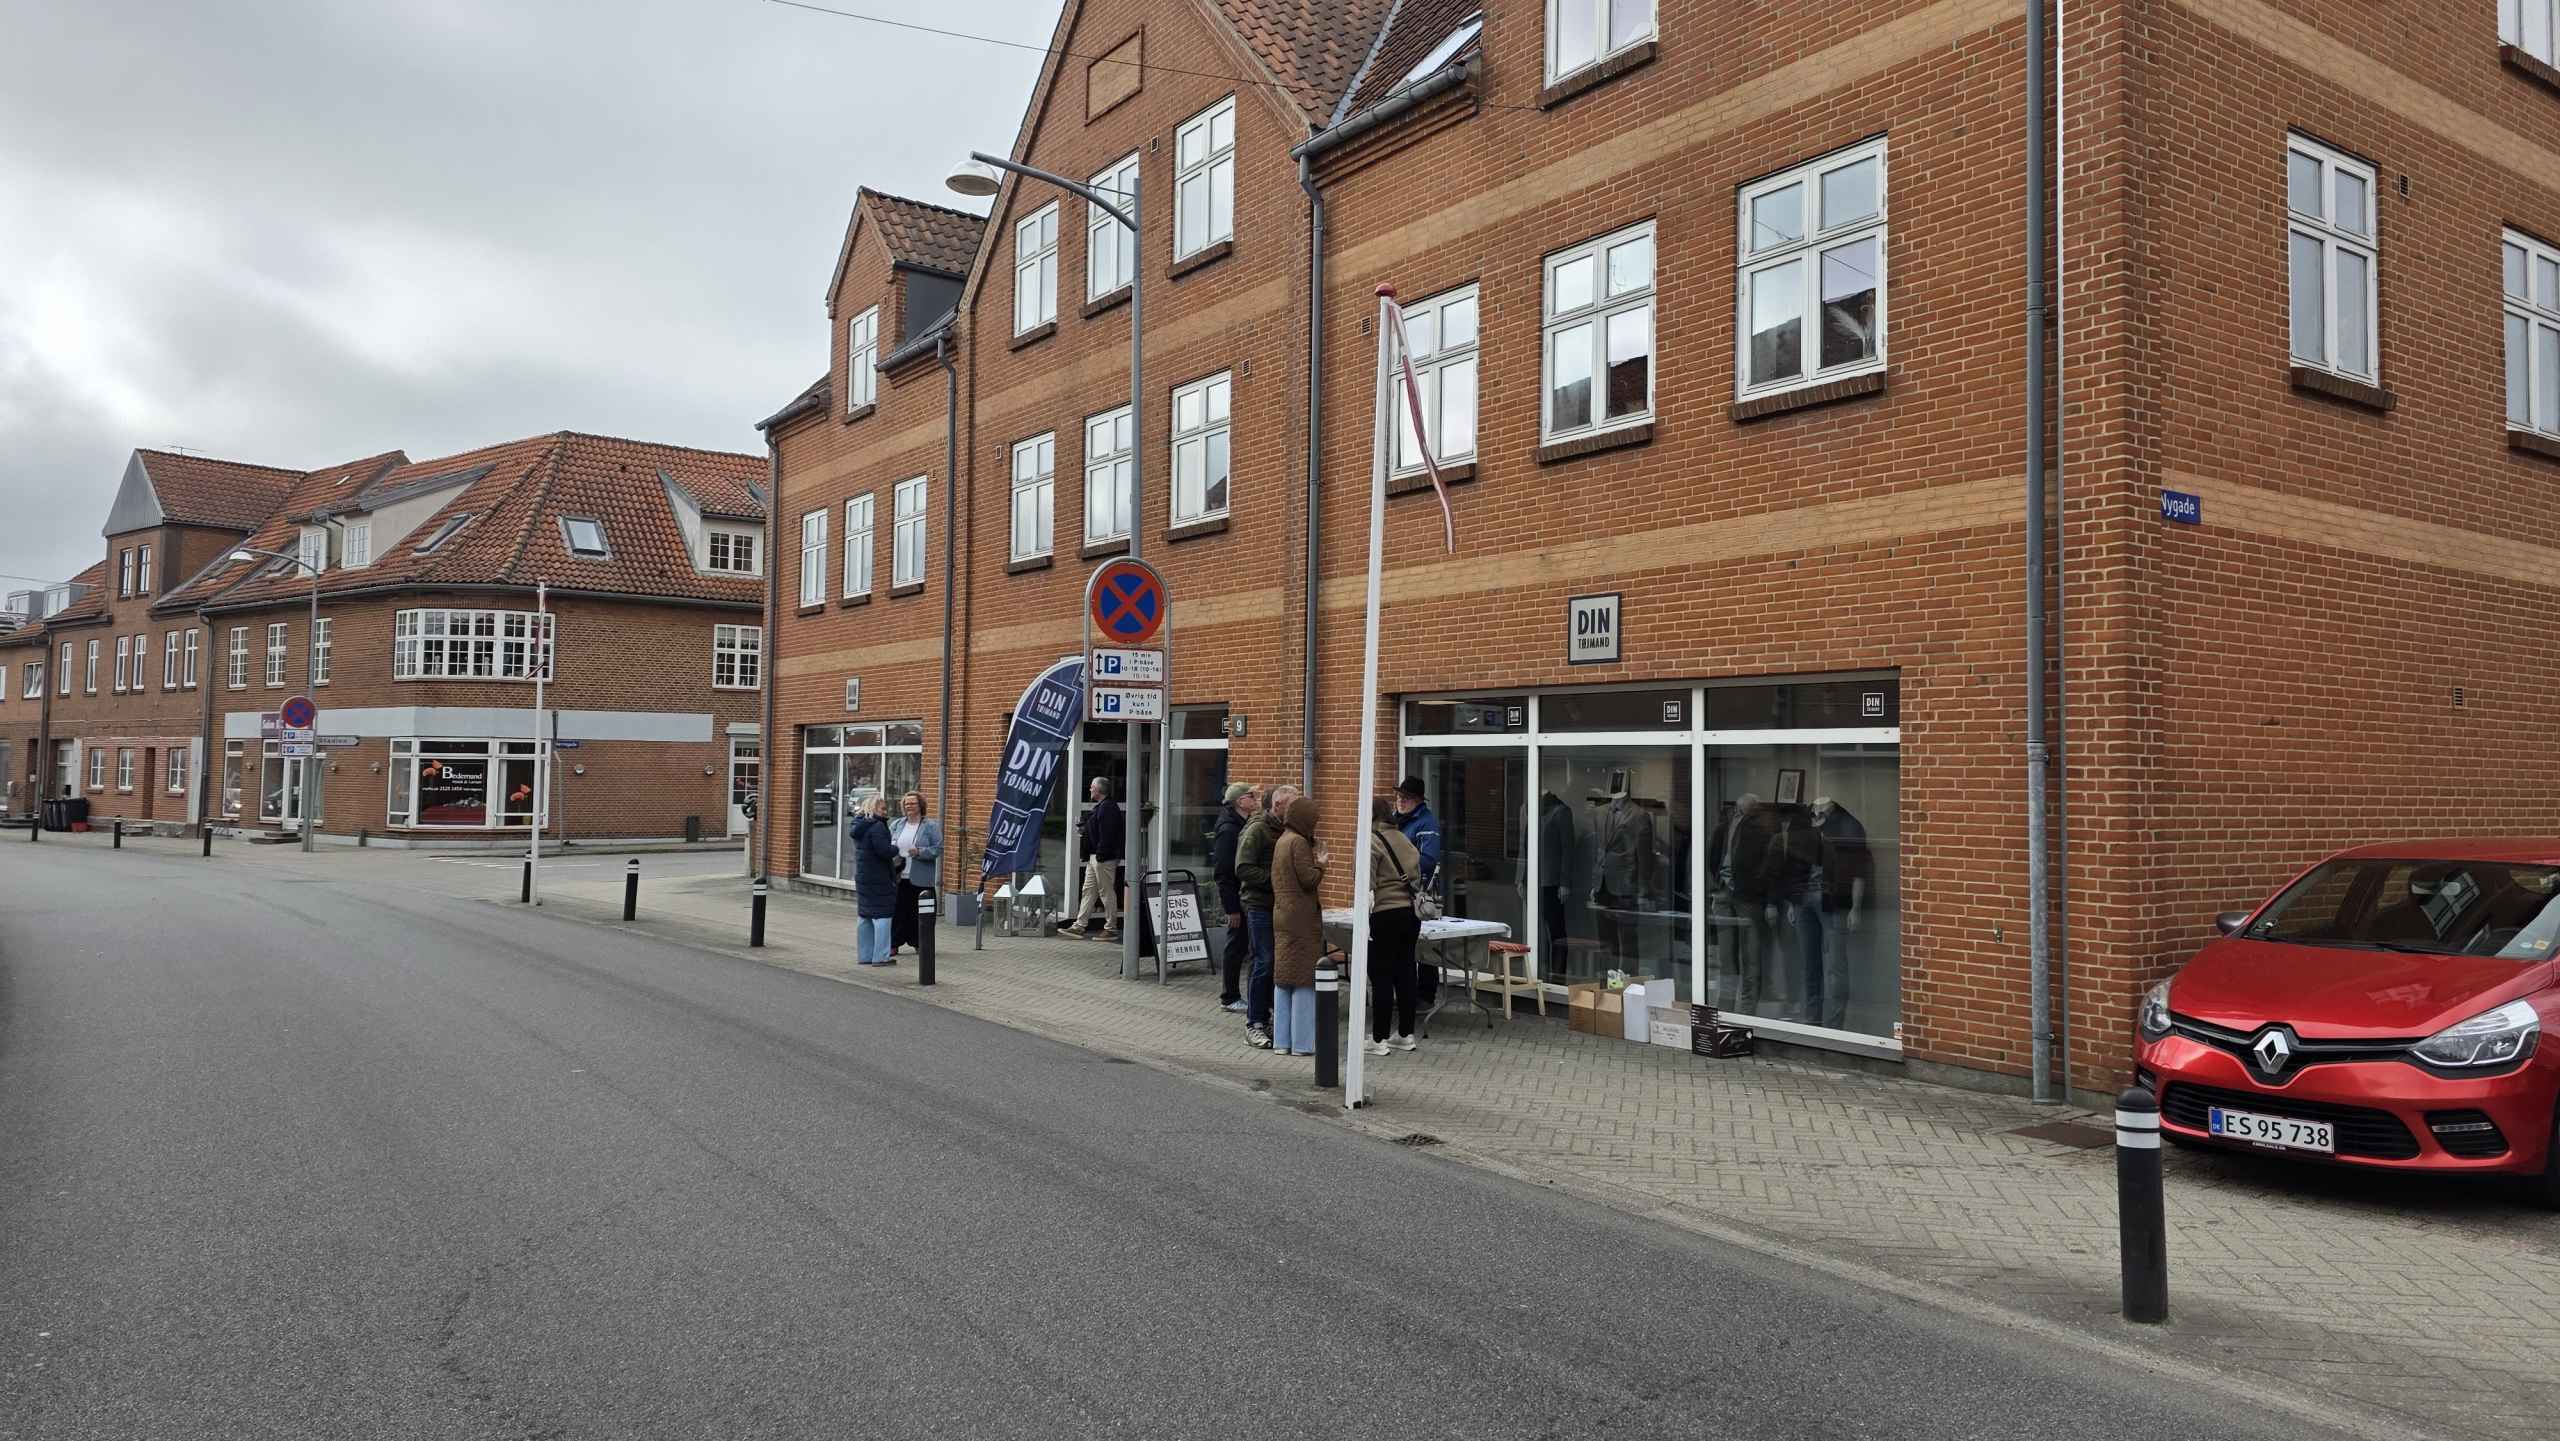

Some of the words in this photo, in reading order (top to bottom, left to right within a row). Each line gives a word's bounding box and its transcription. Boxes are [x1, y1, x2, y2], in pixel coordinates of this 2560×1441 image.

[2161, 492, 2195, 517] Nygade
[1577, 607, 1610, 635] DIN
[1577, 637, 1610, 649] TØJMAND
[1107, 657, 1119, 672] P
[1039, 688, 1067, 712] DIN
[1107, 695, 1118, 711] P
[1866, 697, 1881, 707] DIN
[1036, 703, 1061, 720] TØJMAND
[1236, 719, 1242, 732] 9
[1008, 739, 1060, 781] DIN
[442, 766, 483, 780] Bedemand
[982, 858, 993, 873] IN
[1168, 898, 1189, 909] ENS
[1167, 909, 1191, 920] ASK
[2225, 1114, 2252, 1136] ES
[2257, 1119, 2282, 1140] 95
[2289, 1123, 2330, 1147] 738
